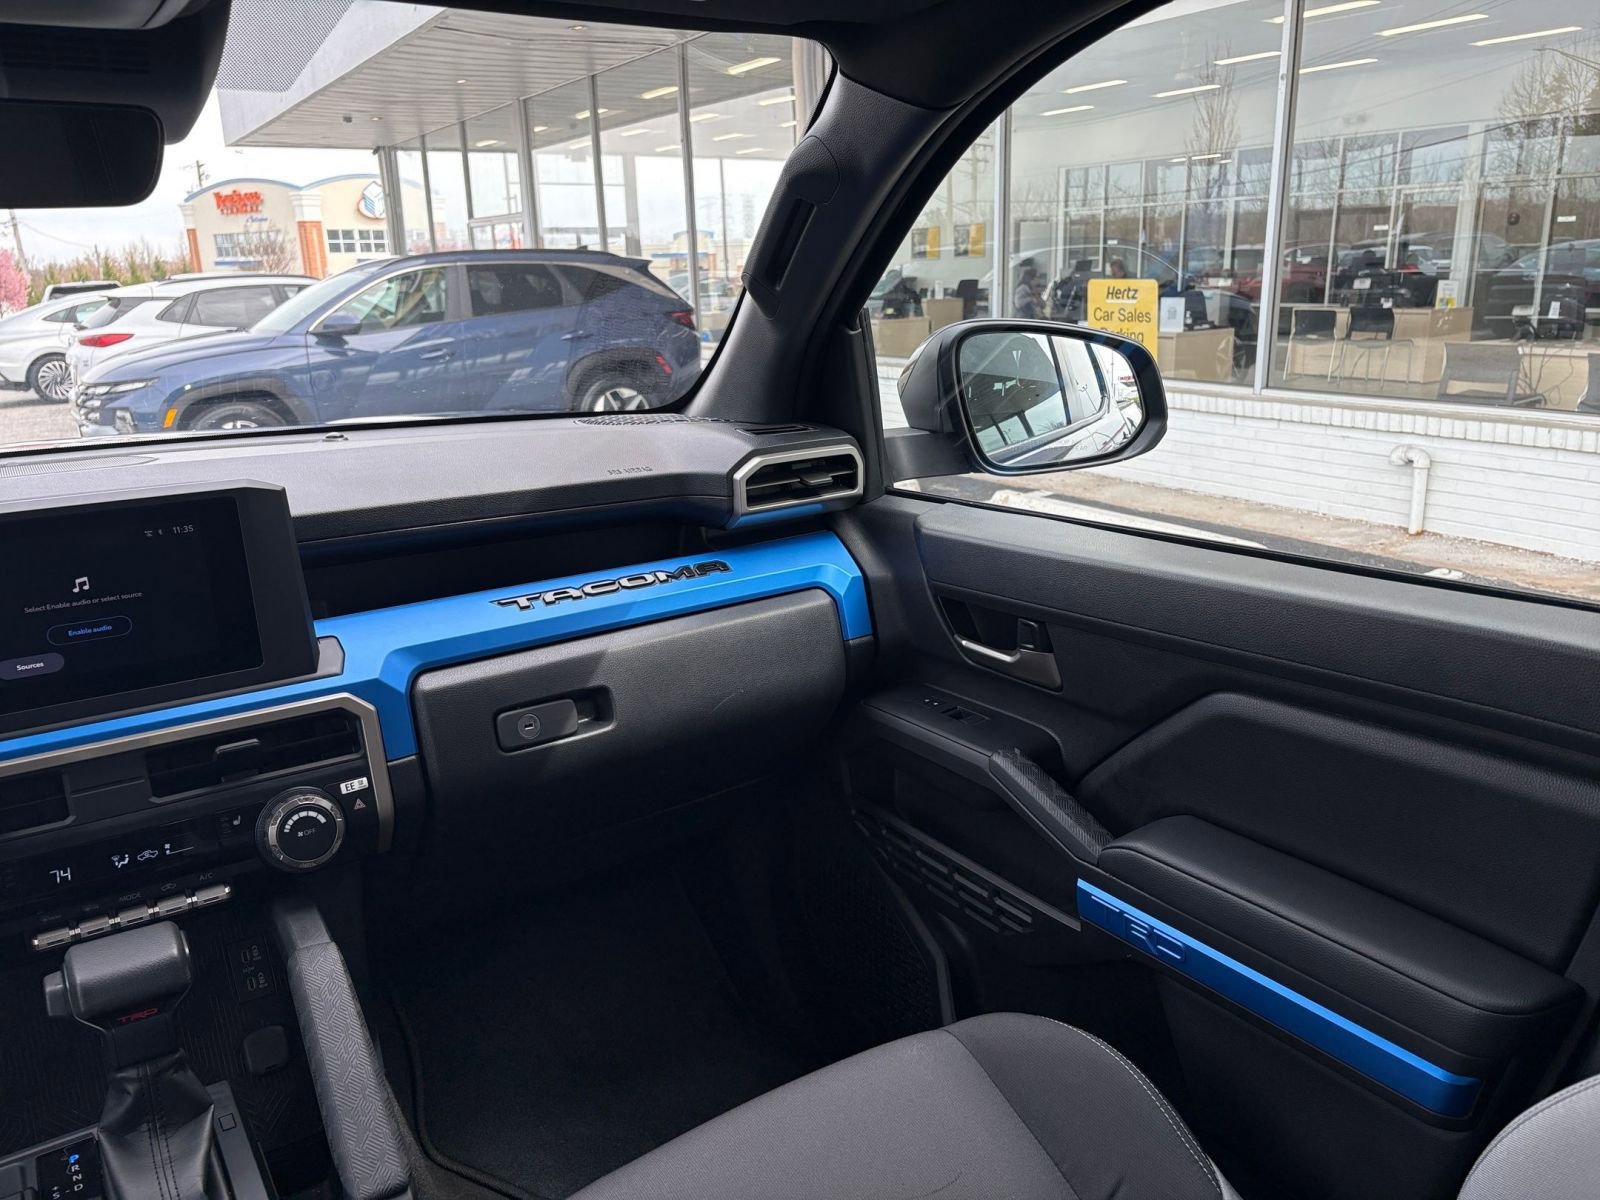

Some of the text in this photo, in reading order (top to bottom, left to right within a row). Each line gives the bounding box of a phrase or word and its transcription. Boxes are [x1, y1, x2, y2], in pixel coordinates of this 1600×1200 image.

[1106, 286, 1138, 300] Hertz
[1093, 307, 1151, 323] Car Sales
[173, 524, 194, 535] 11:35
[490, 559, 733, 611] TACOMA
[24, 591, 143, 614] Select Enable audio or select source
[68, 623, 112, 638] Enable audio
[16, 661, 45, 672] Sources
[49, 866, 72, 884] 74
